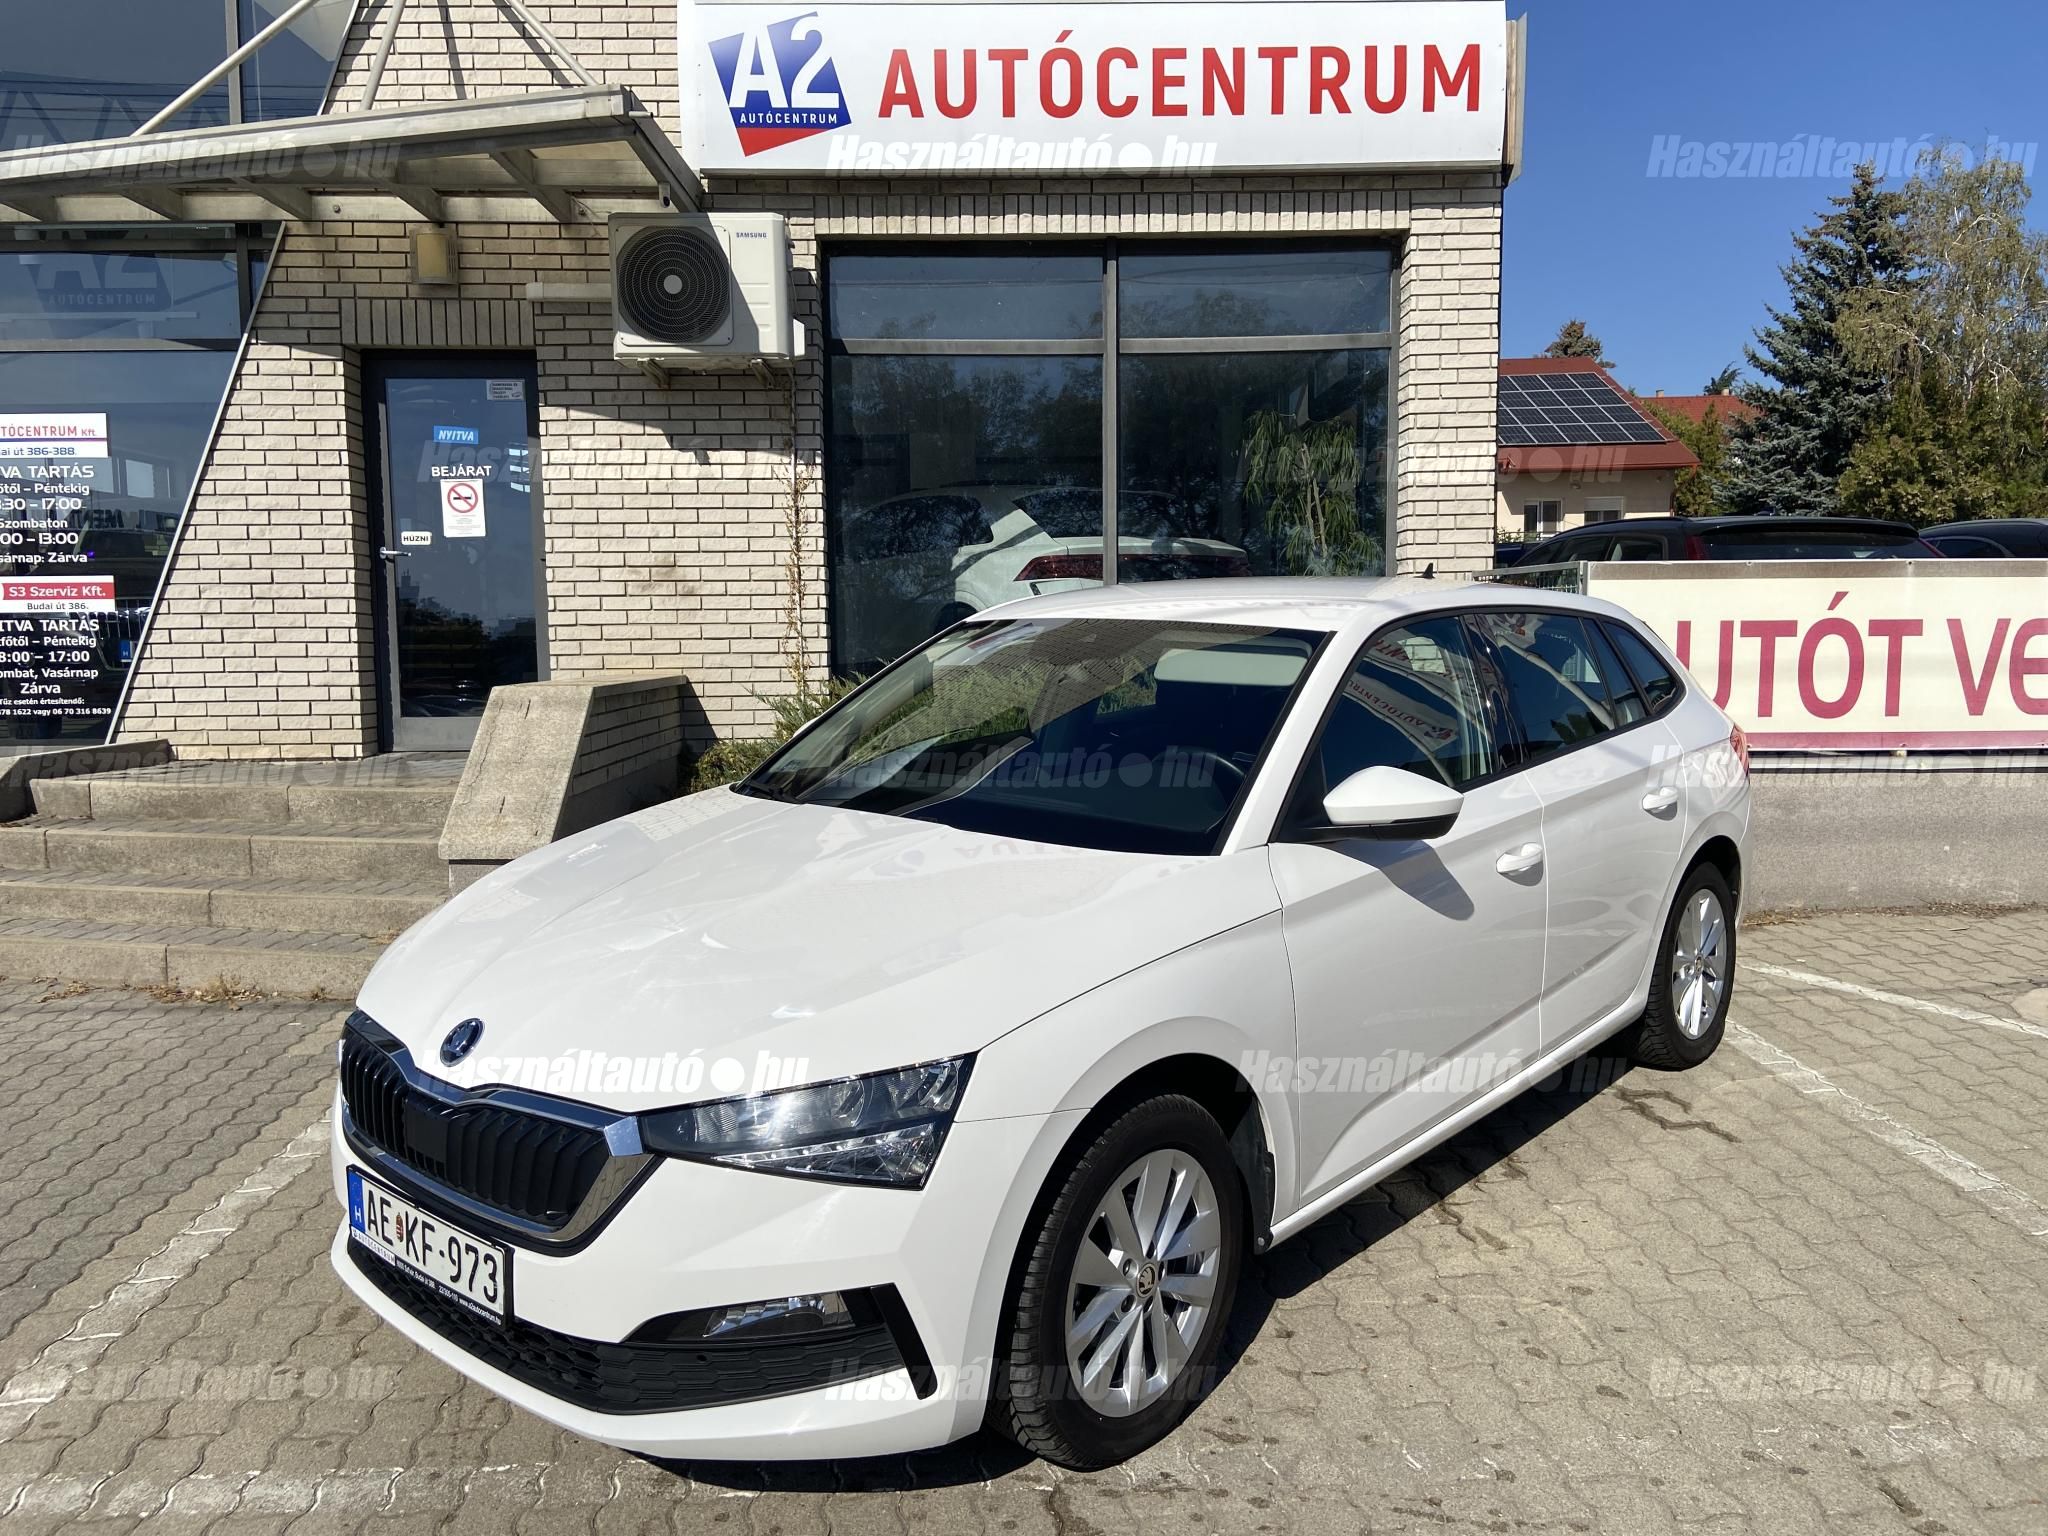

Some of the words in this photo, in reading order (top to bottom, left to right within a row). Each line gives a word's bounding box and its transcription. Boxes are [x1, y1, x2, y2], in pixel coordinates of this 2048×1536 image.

[729, 16, 839, 108] A2
[878, 30, 1481, 118] AUTÓCENTRUM
[740, 111, 837, 124] AUTÓCENTRUM
[438, 430, 474, 441] NYITVA
[27, 462, 94, 479] TARTÁS
[432, 464, 492, 477] BEJÁRAT
[35, 482, 90, 496] Péntekig
[39, 532, 78, 545] 13:00
[48, 551, 88, 563] Zárva
[9, 586, 26, 597] S3
[30, 586, 78, 597] Szerviz
[82, 585, 106, 597] Kft.
[27, 602, 53, 610] Budai
[56, 601, 65, 610] út
[68, 602, 89, 610] 386.
[39, 617, 99, 632] TARTÁS
[0, 635, 29, 647] főtől
[44, 636, 97, 648] Péntekig
[49, 651, 90, 662] 17:00
[41, 667, 99, 680] Vasárnap
[20, 682, 61, 694] Zárva
[14, 698, 38, 706] esetén
[13, 708, 31, 716] 1622
[33, 709, 51, 718] vagy
[52, 708, 62, 716] 06
[65, 708, 74, 716] 70
[76, 708, 90, 716] 316
[354, 1205, 362, 1223] H
